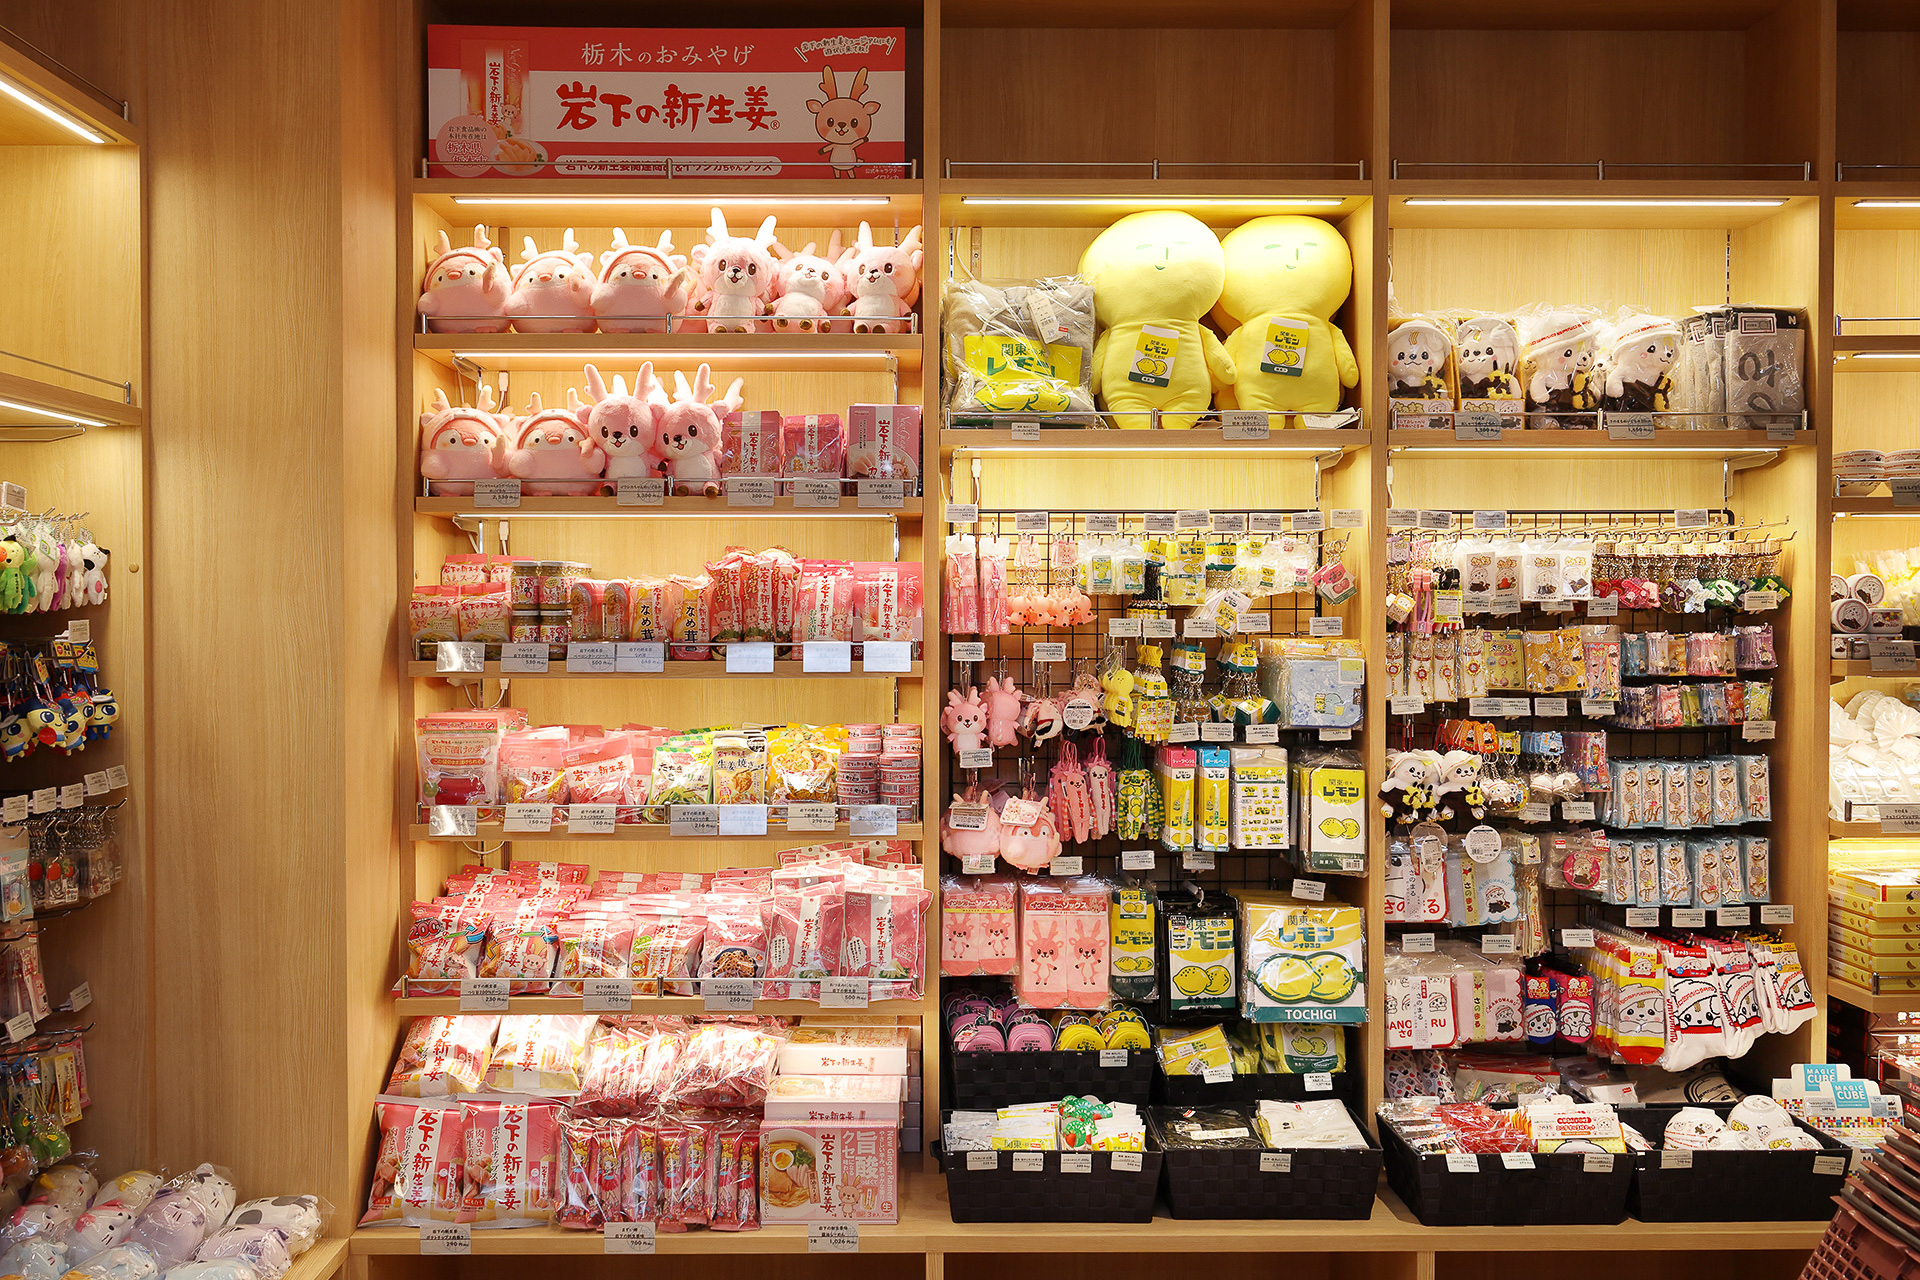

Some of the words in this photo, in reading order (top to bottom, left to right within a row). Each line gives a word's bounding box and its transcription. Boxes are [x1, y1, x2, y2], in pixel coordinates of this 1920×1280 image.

[581, 42, 755, 67] 栃木のおみやげ
[488, 61, 501, 126] 岩下の新生姜
[447, 141, 482, 153] 栃木県
[1274, 335, 1300, 346] レモン
[1144, 344, 1170, 355] レモン
[461, 575, 479, 583] スープ
[759, 567, 771, 624] 岩下の新生姜
[411, 600, 450, 611] 岩下の新生姜
[461, 602, 502, 611] 岩下の新生姜
[429, 611, 449, 619] スープ
[480, 611, 501, 619] スープ
[640, 604, 654, 641] なめ茸
[684, 606, 698, 643] なめ茸
[1323, 786, 1359, 797] レモン
[1287, 915, 1325, 926] 関東・栃木
[1279, 927, 1334, 942] レモン
[1115, 936, 1153, 945] レモン
[1285, 1009, 1337, 1020] TOCHIGI
[821, 1057, 865, 1067] 岩下の新生姜
[1807, 1074, 1836, 1084] CUBE
[1835, 1084, 1864, 1092] MAGIC
[1836, 1090, 1867, 1100] CUBE
[842, 1131, 855, 1158] クセ
[405, 1109, 442, 1208] 岩下の新生姜
[491, 1127, 500, 1180] ポテトチップス
[499, 1105, 525, 1211] 岩下の新生姜
[856, 1131, 878, 1179] 旨酸
[886, 1148, 894, 1175] Ginger
[820, 1133, 836, 1214] 岩下の新生姜
[882, 1202, 891, 1212] 生
